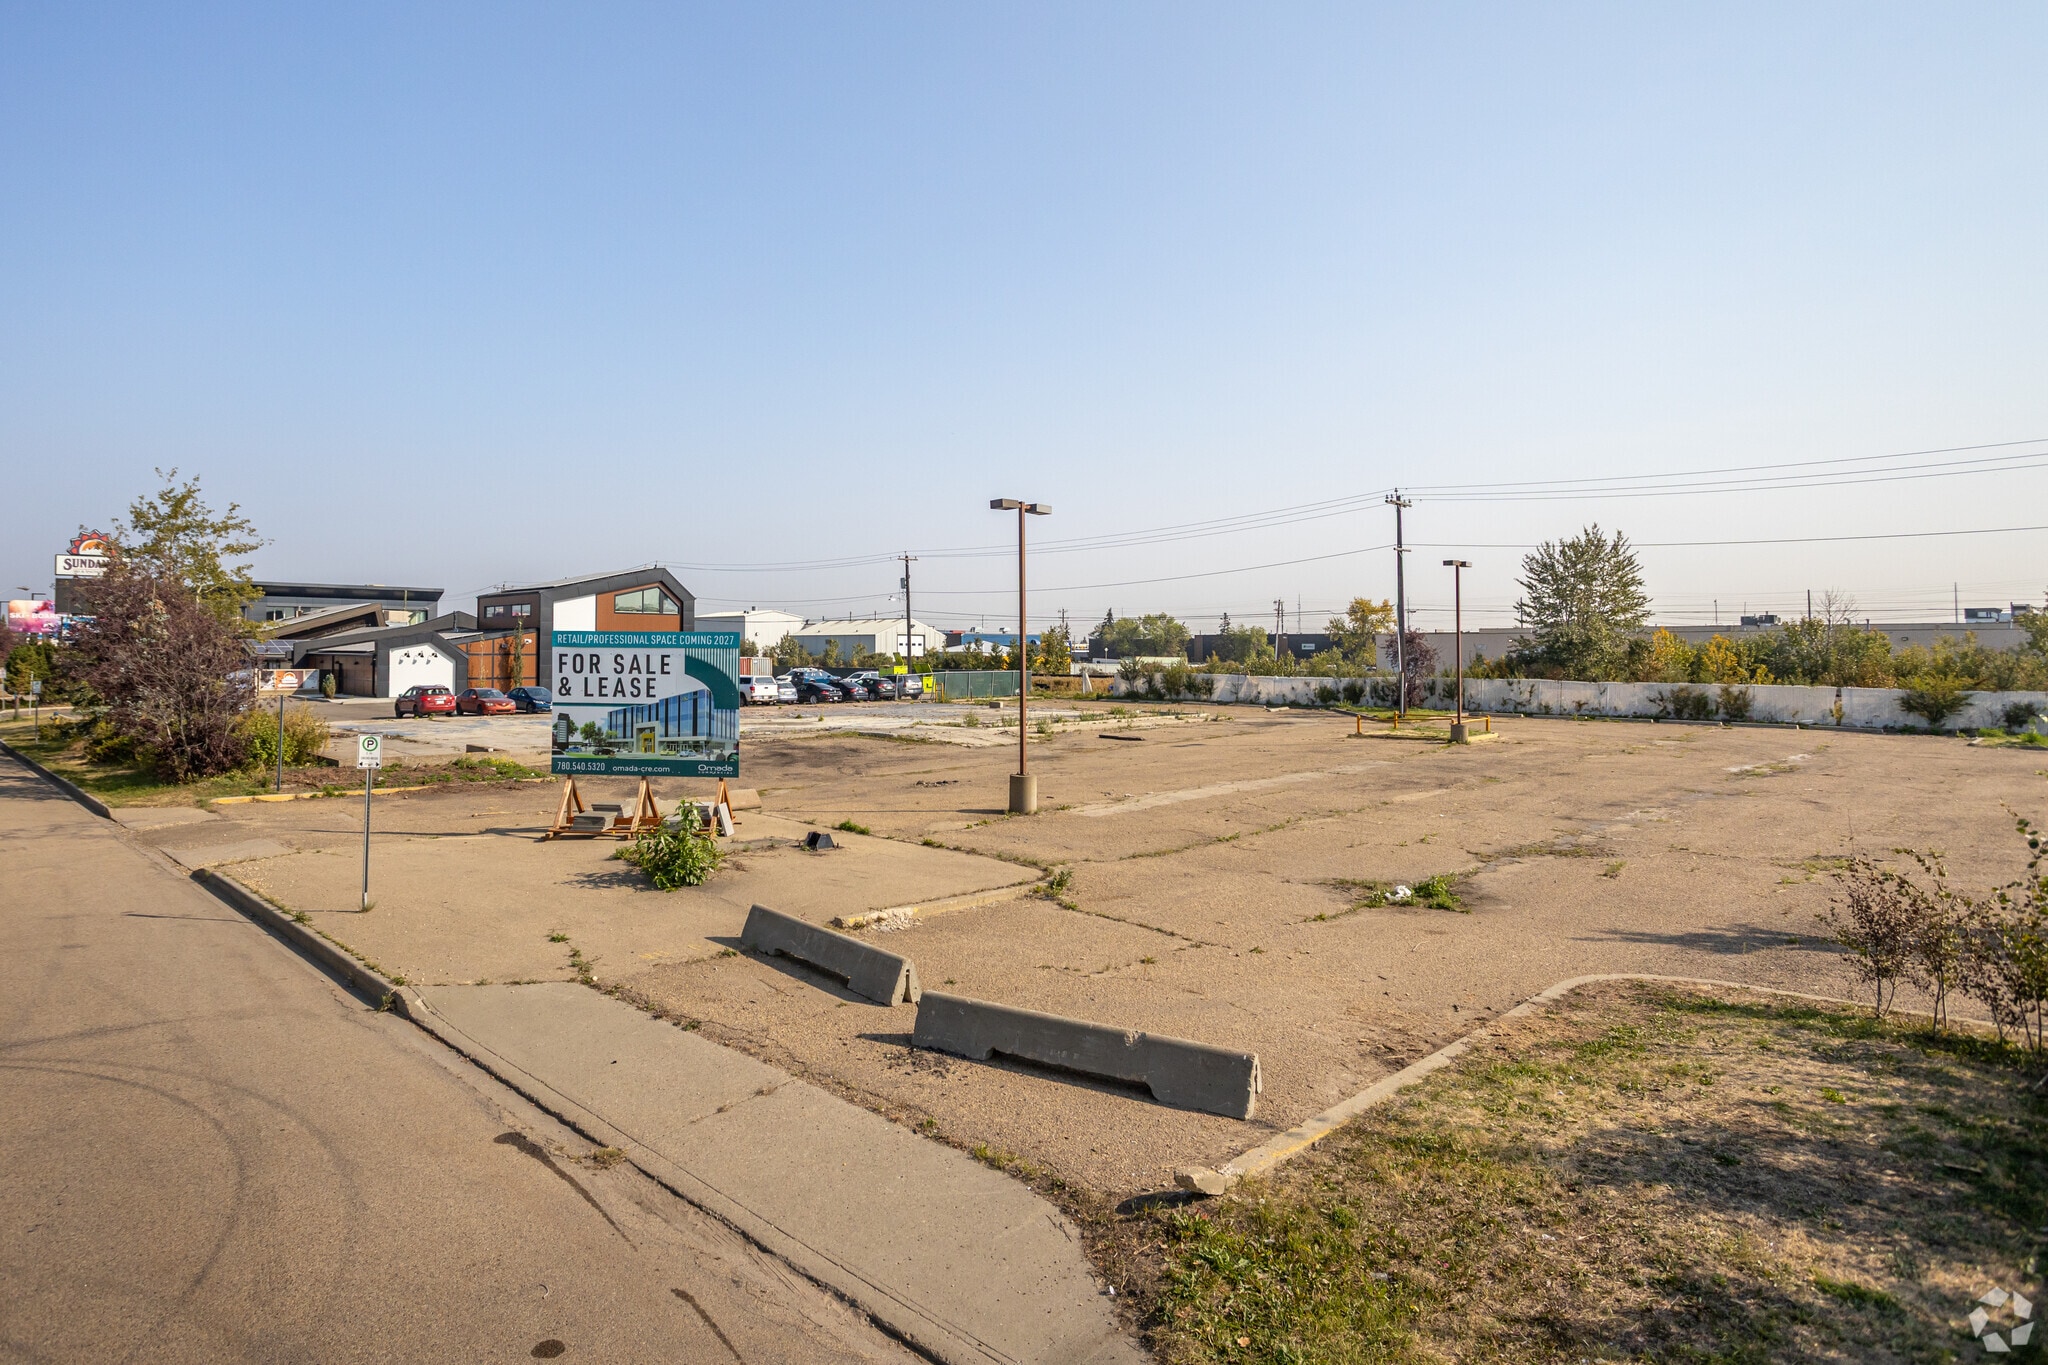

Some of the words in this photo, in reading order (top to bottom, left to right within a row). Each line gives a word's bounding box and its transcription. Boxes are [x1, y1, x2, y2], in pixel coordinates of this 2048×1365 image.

[557, 634, 649, 645] RETAIL/PROFESSIONAL
[651, 635, 677, 645] SPACE
[679, 635, 712, 645] COMING
[714, 635, 734, 646] 2027
[558, 653, 601, 674] FOR
[613, 653, 671, 675] SALE
[558, 676, 572, 697] &
[584, 677, 657, 698] LEASE
[367, 740, 375, 748] P
[557, 761, 606, 771] 780.540.5320
[612, 765, 671, 773] omada-cre.com
[697, 764, 733, 772] Omada
